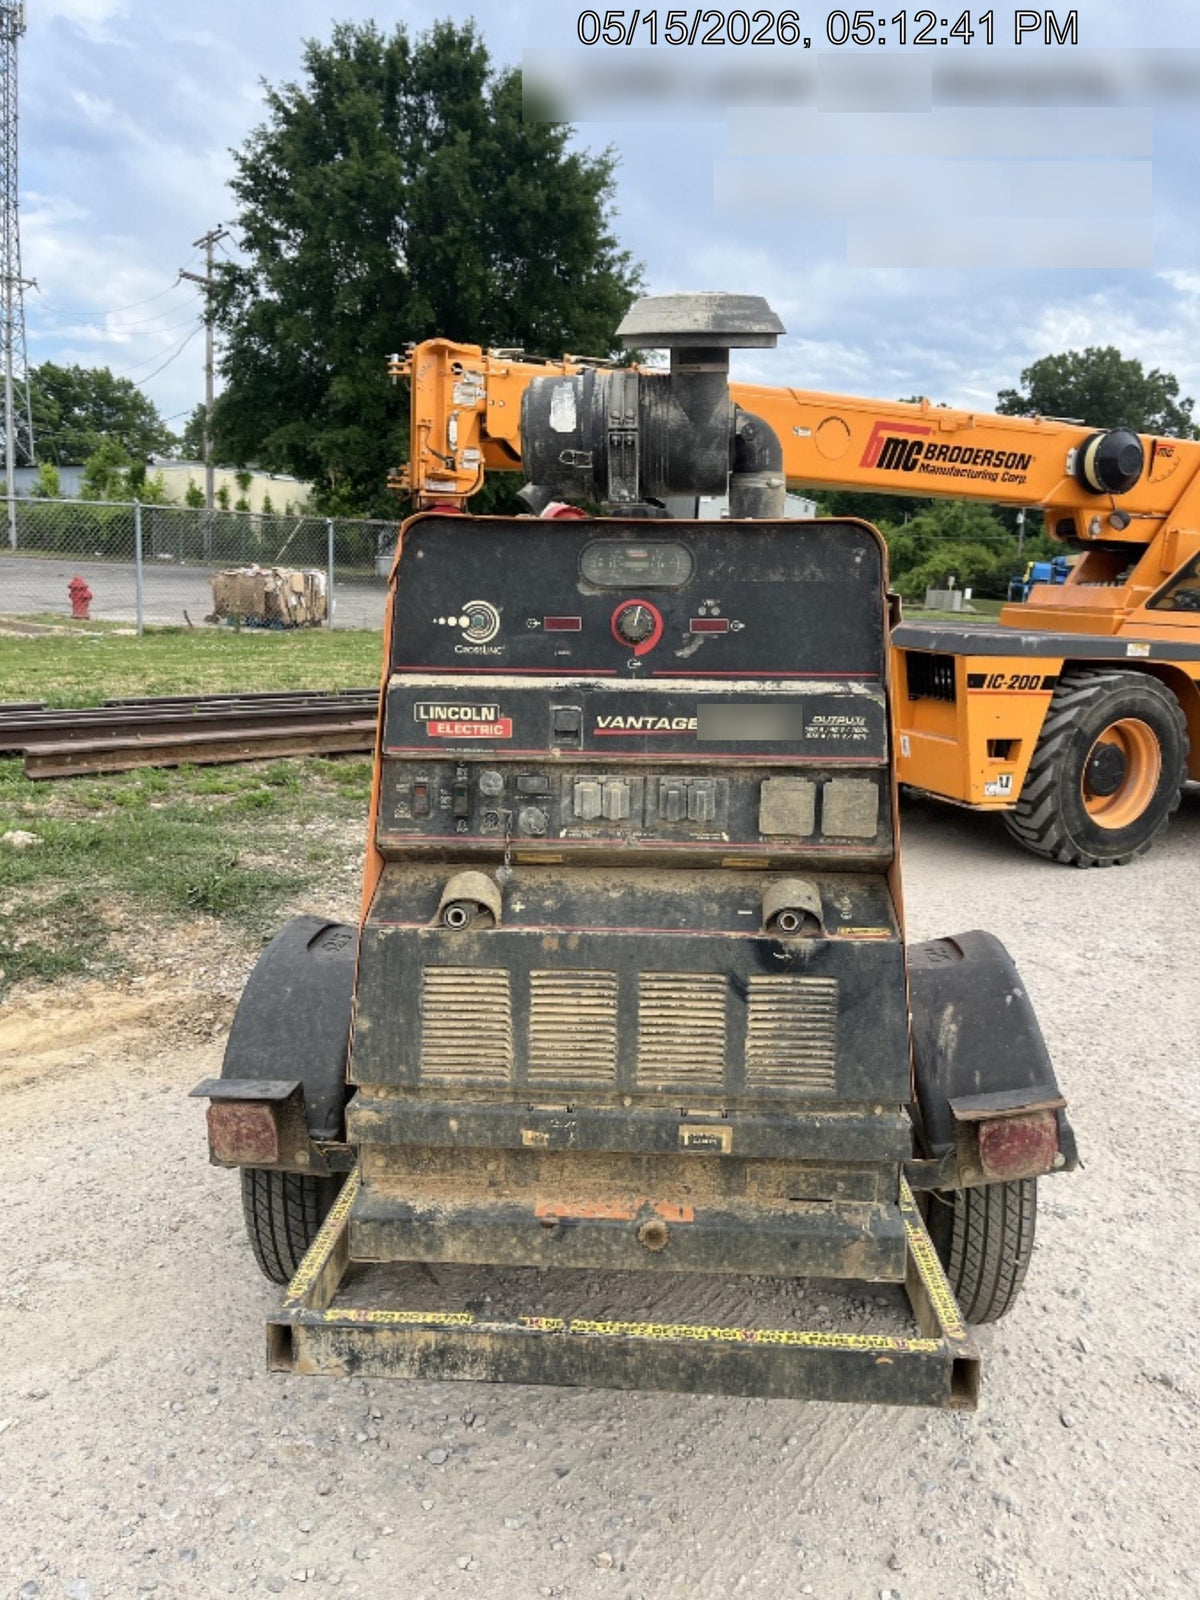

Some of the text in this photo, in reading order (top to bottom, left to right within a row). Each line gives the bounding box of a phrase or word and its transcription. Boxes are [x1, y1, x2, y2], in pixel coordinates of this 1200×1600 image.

[923, 443, 1032, 470] BRODERSON
[917, 463, 999, 482] Manufacturing
[986, 674, 1041, 690] IC-200
[419, 705, 496, 721] LINCOLN
[437, 723, 504, 736] ELECTRIC
[596, 715, 698, 730] VANTAGE
